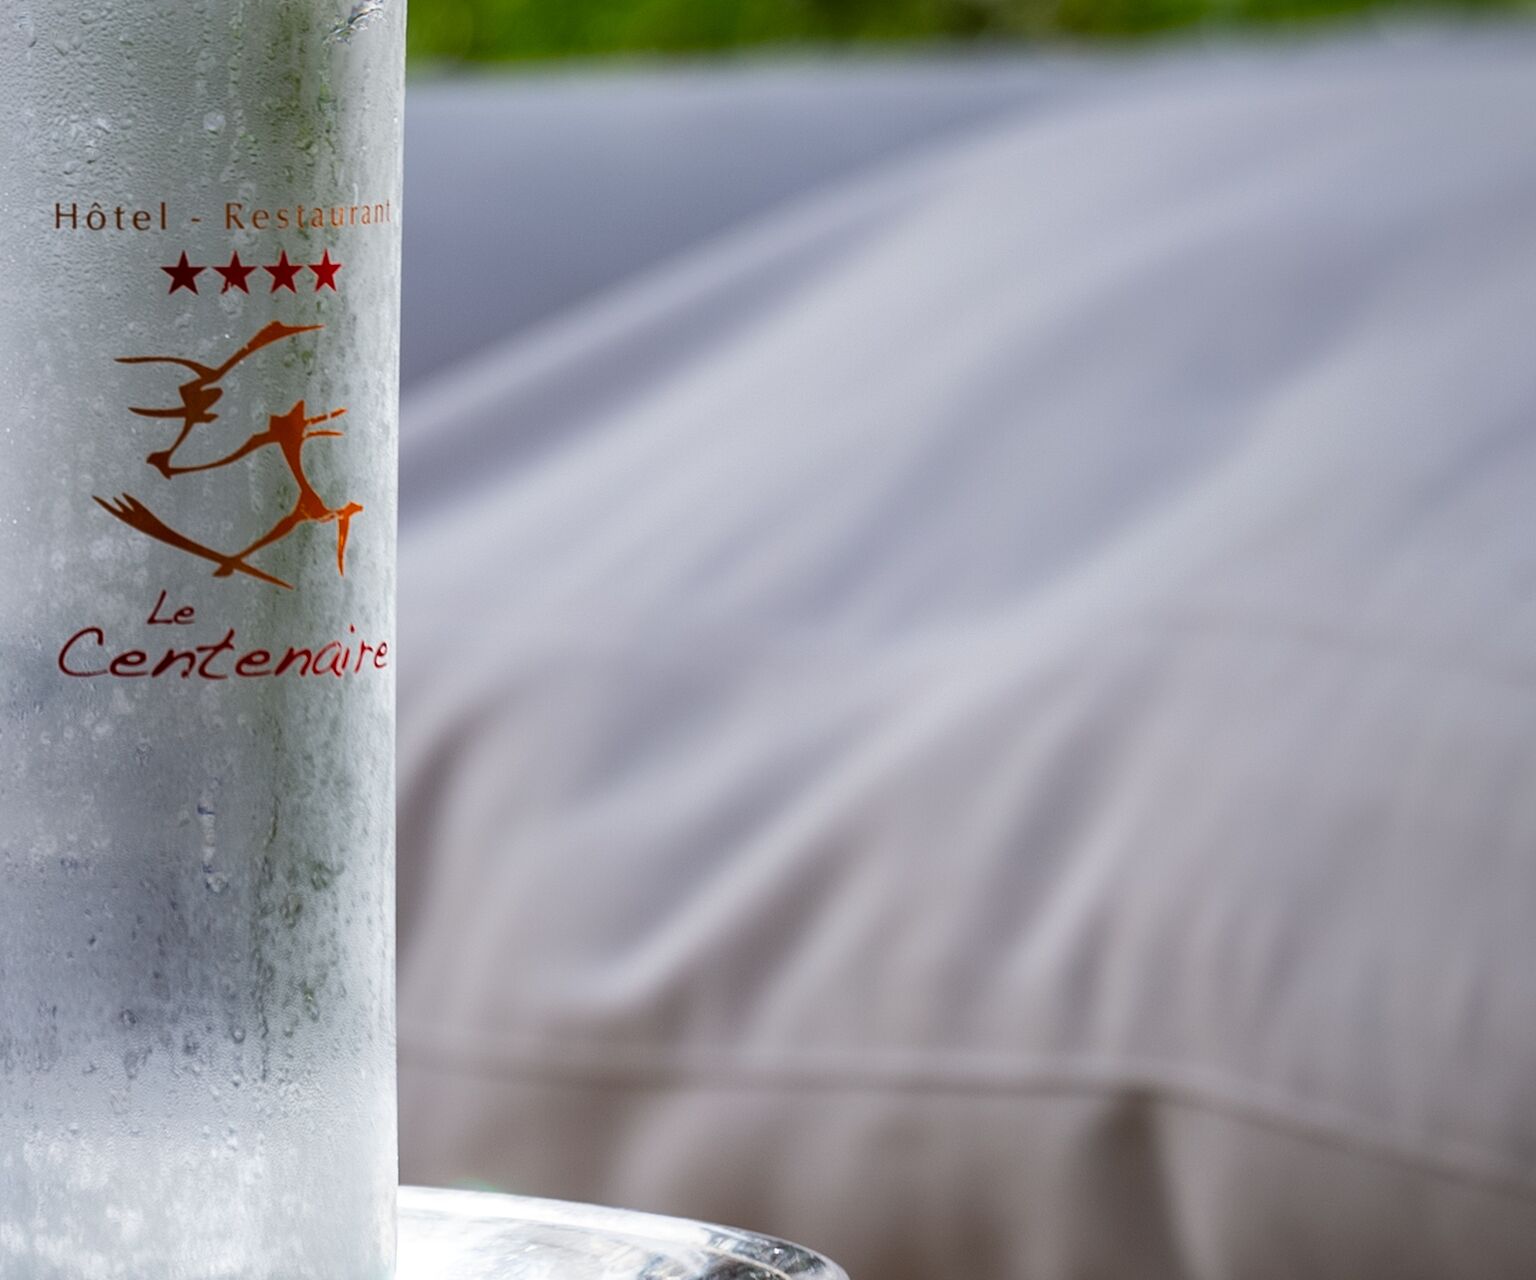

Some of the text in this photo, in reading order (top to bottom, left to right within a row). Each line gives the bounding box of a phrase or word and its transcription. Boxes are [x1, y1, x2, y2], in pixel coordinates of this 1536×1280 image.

[54, 202, 168, 230] Hôtel
[224, 199, 391, 230] Restaurant
[147, 589, 195, 625] Le
[58, 624, 388, 680] Centenaire
